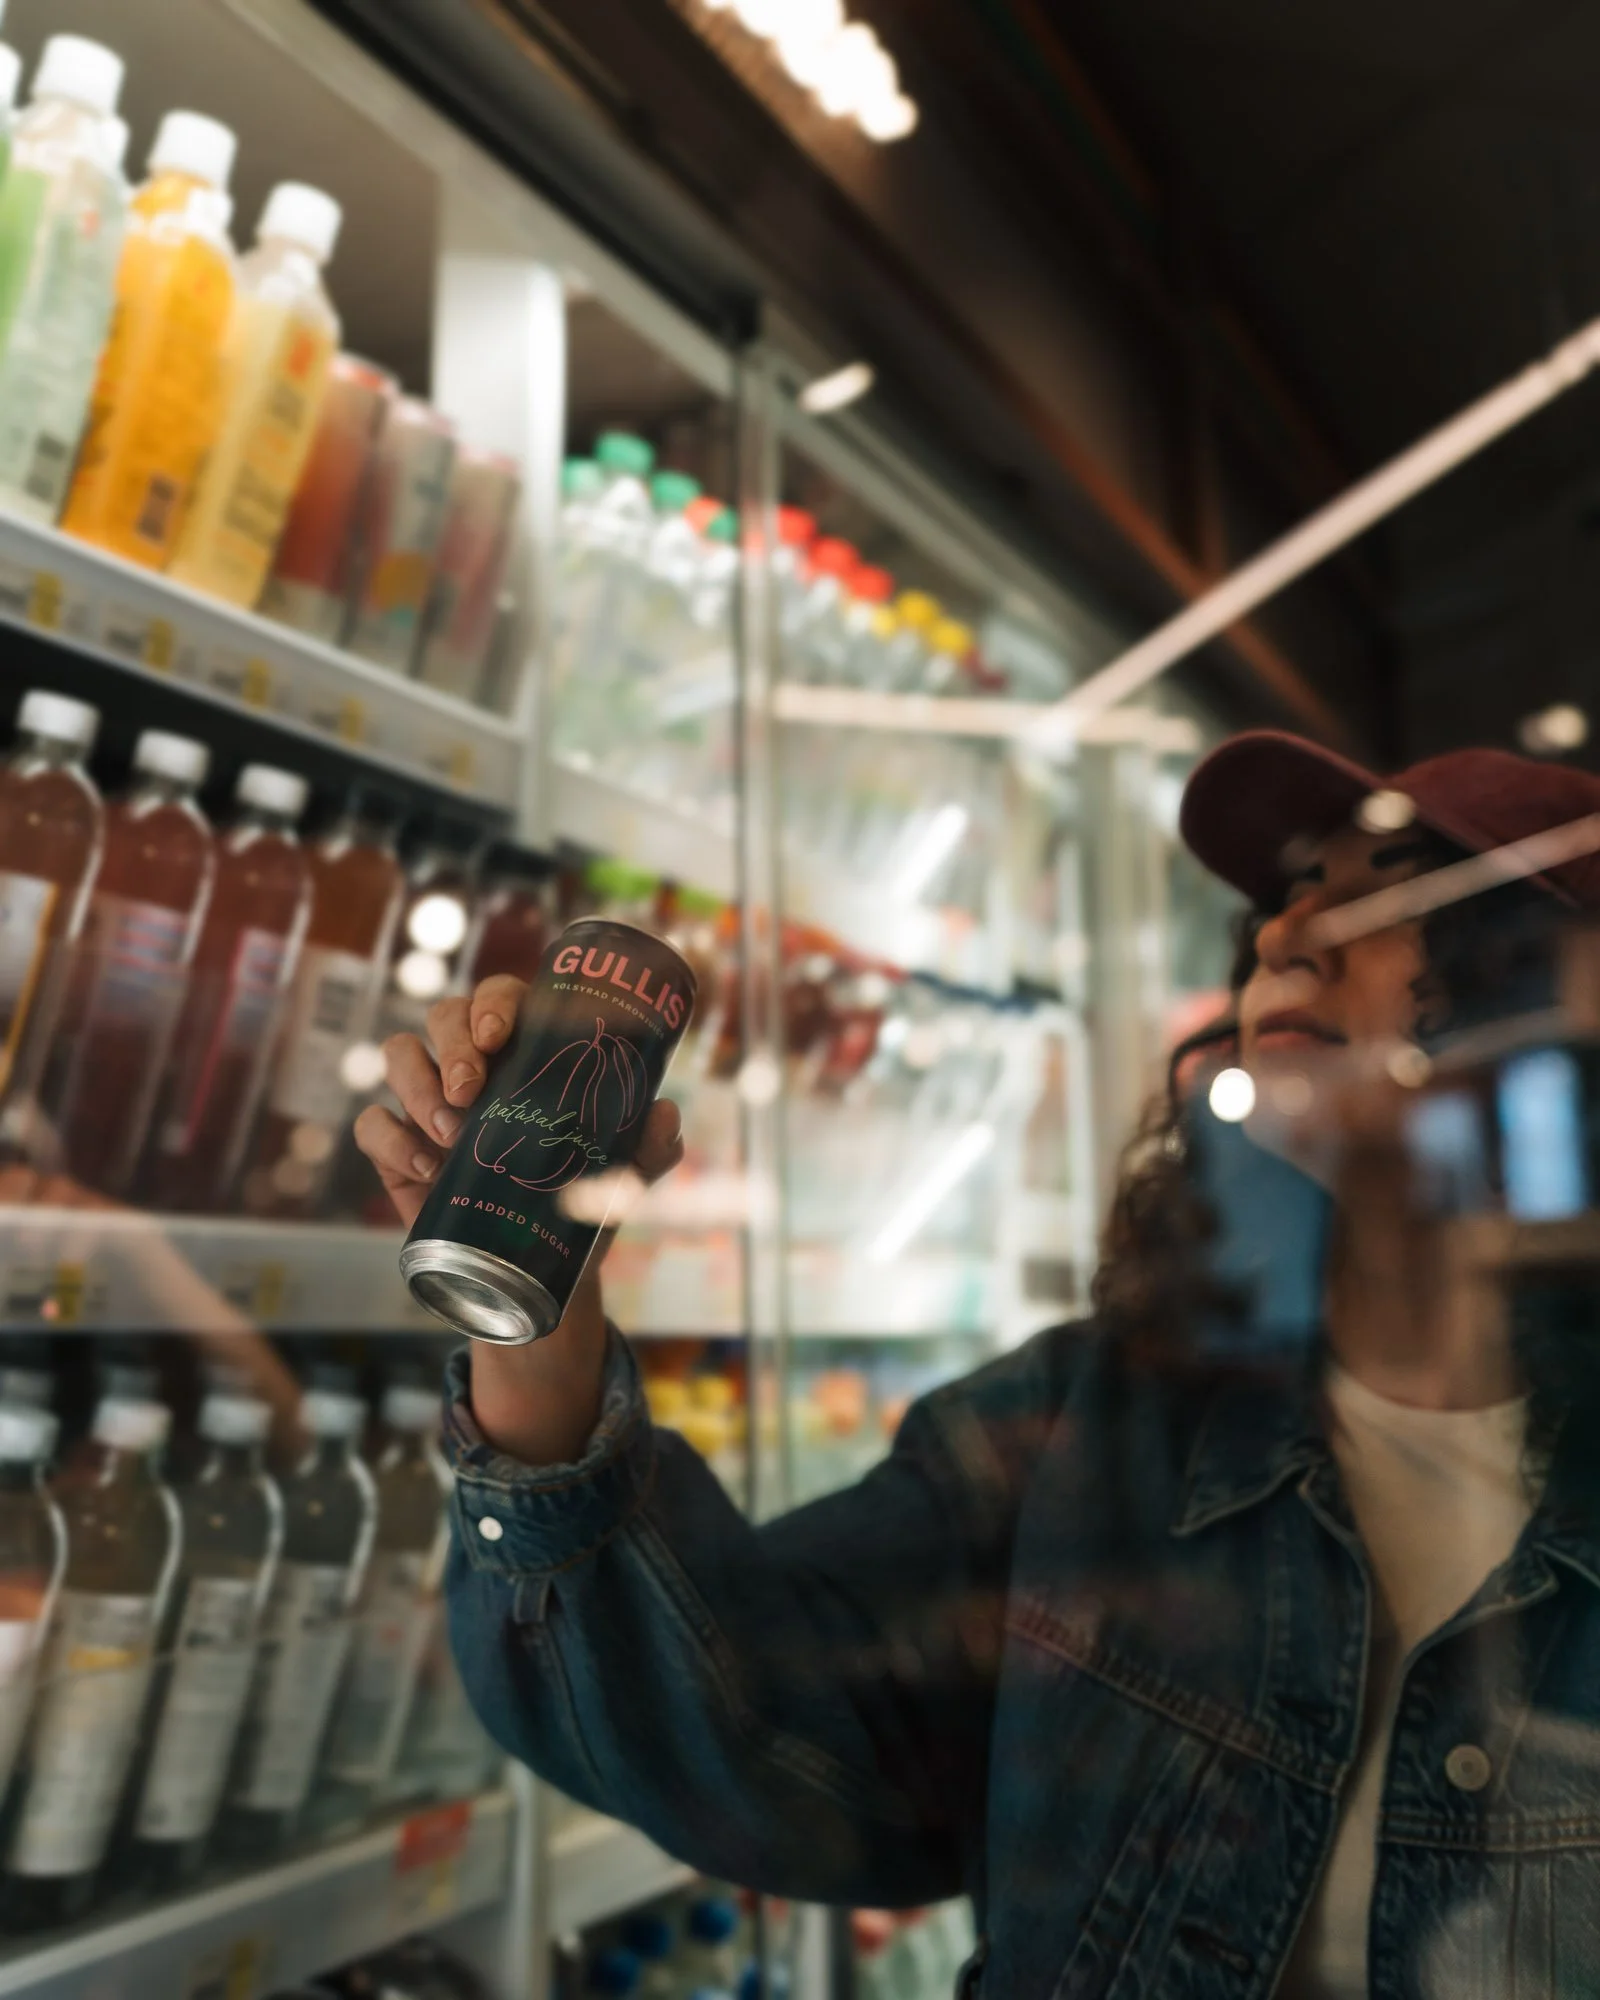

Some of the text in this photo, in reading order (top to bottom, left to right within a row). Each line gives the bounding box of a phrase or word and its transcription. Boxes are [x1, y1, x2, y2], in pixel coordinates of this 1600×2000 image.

[552, 945, 685, 1030] GULLIS
[552, 982, 609, 1000] KOLSYRAD
[539, 1126, 608, 1165] juice
[450, 1196, 571, 1259] NO ADDED SUGAR
